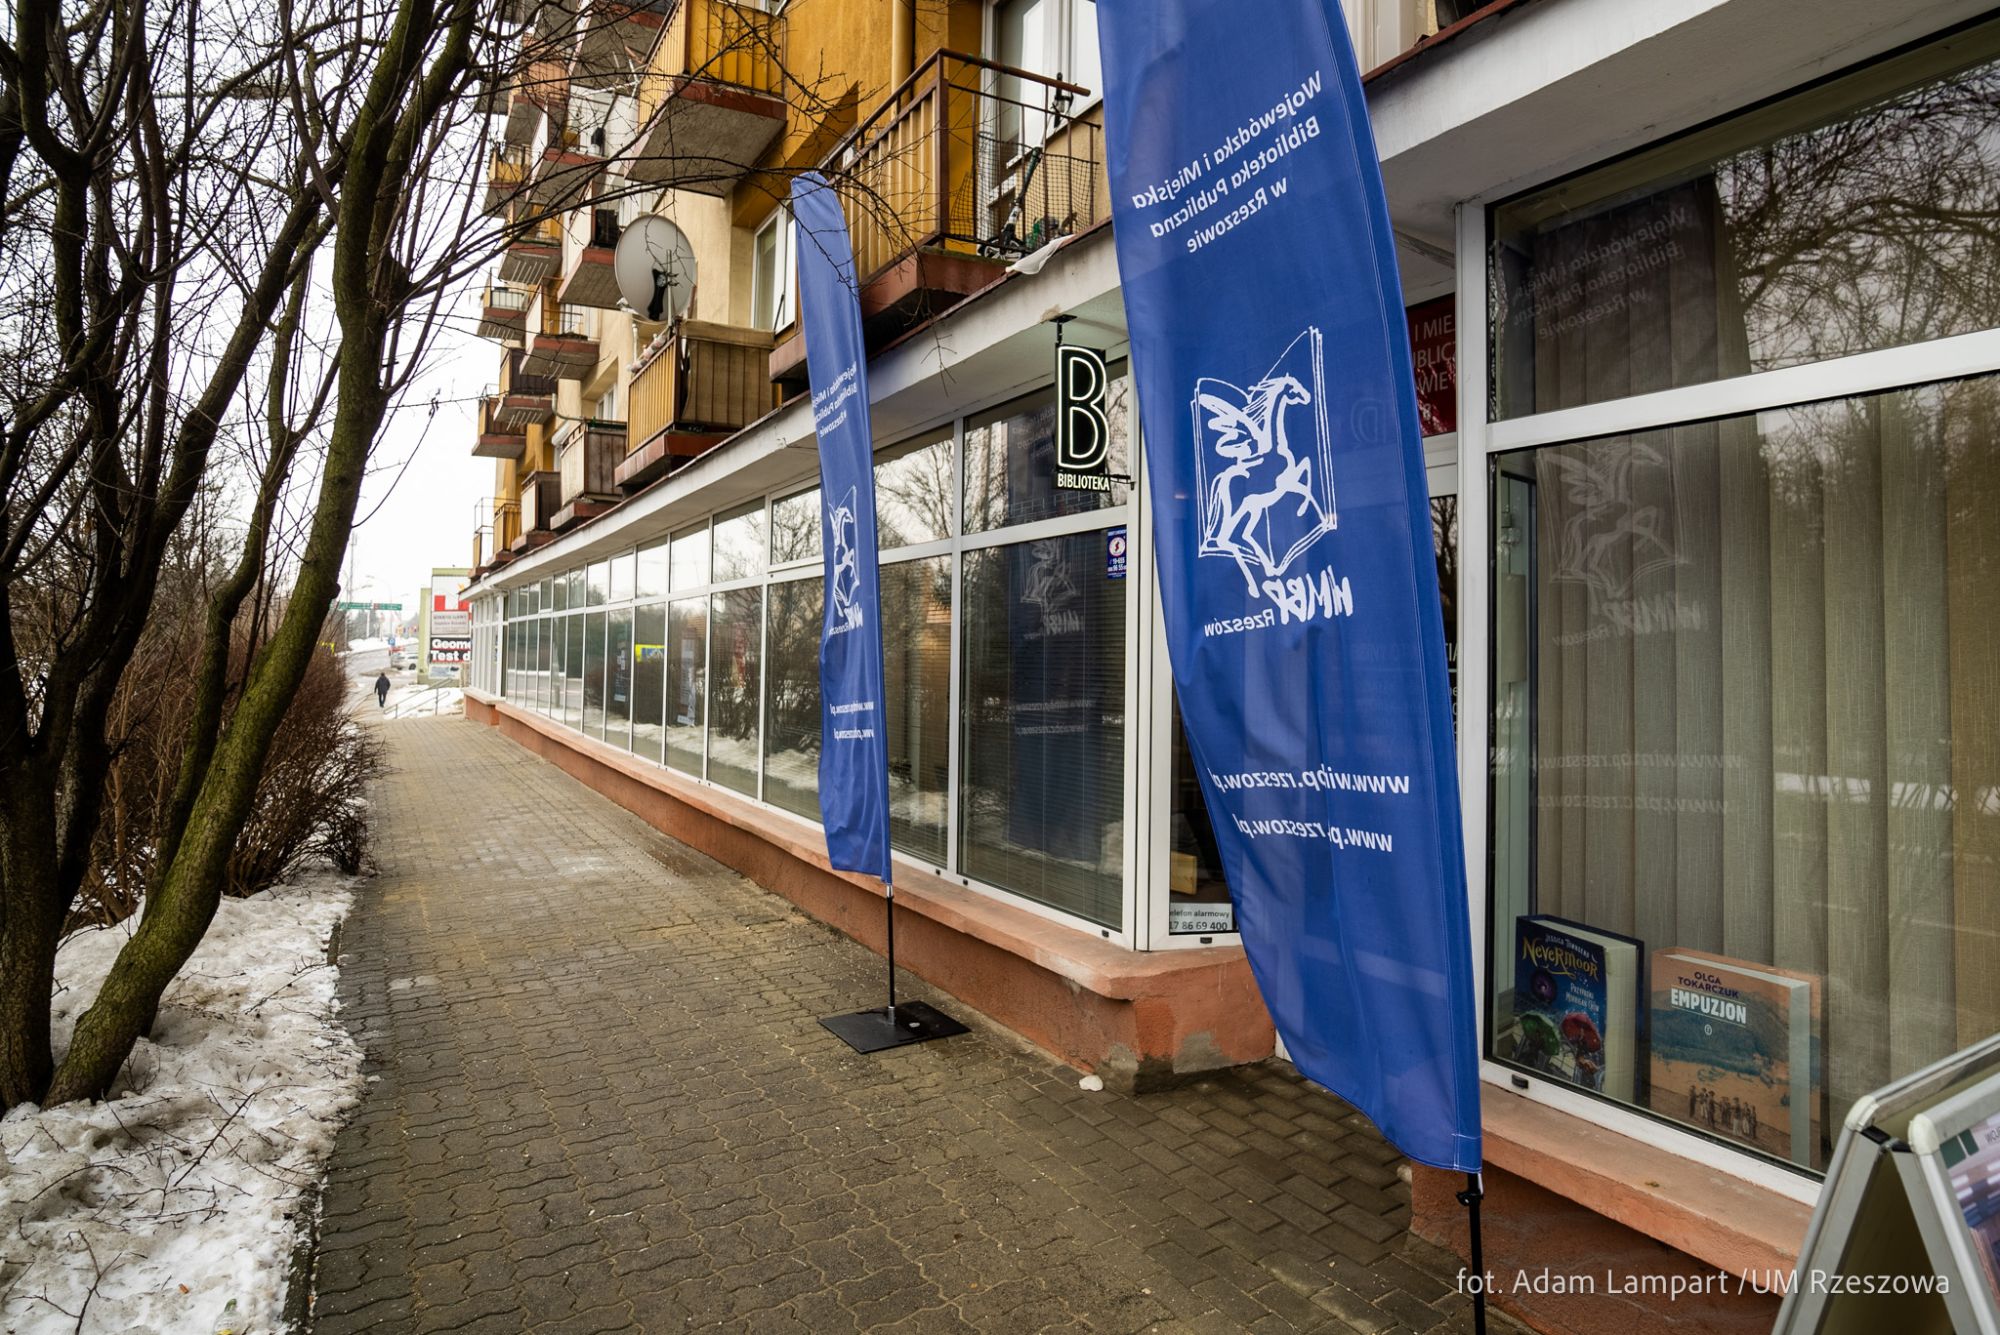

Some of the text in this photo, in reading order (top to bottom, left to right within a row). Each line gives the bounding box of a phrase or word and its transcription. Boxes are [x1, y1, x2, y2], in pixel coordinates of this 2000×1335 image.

[1423, 314, 1456, 340] MIE
[1418, 371, 1448, 394] WIE
[1058, 346, 1110, 469] B
[1057, 472, 1110, 492] BIBLIOTEKA
[431, 650, 459, 661] Test
[1182, 921, 1194, 930] 86
[1196, 921, 1208, 930] 69
[1210, 921, 1228, 931] 400
[1677, 976, 1739, 999] TOKARCZUK
[1694, 971, 1722, 985] OLGA
[1671, 988, 1747, 1024] EMPUZJON
